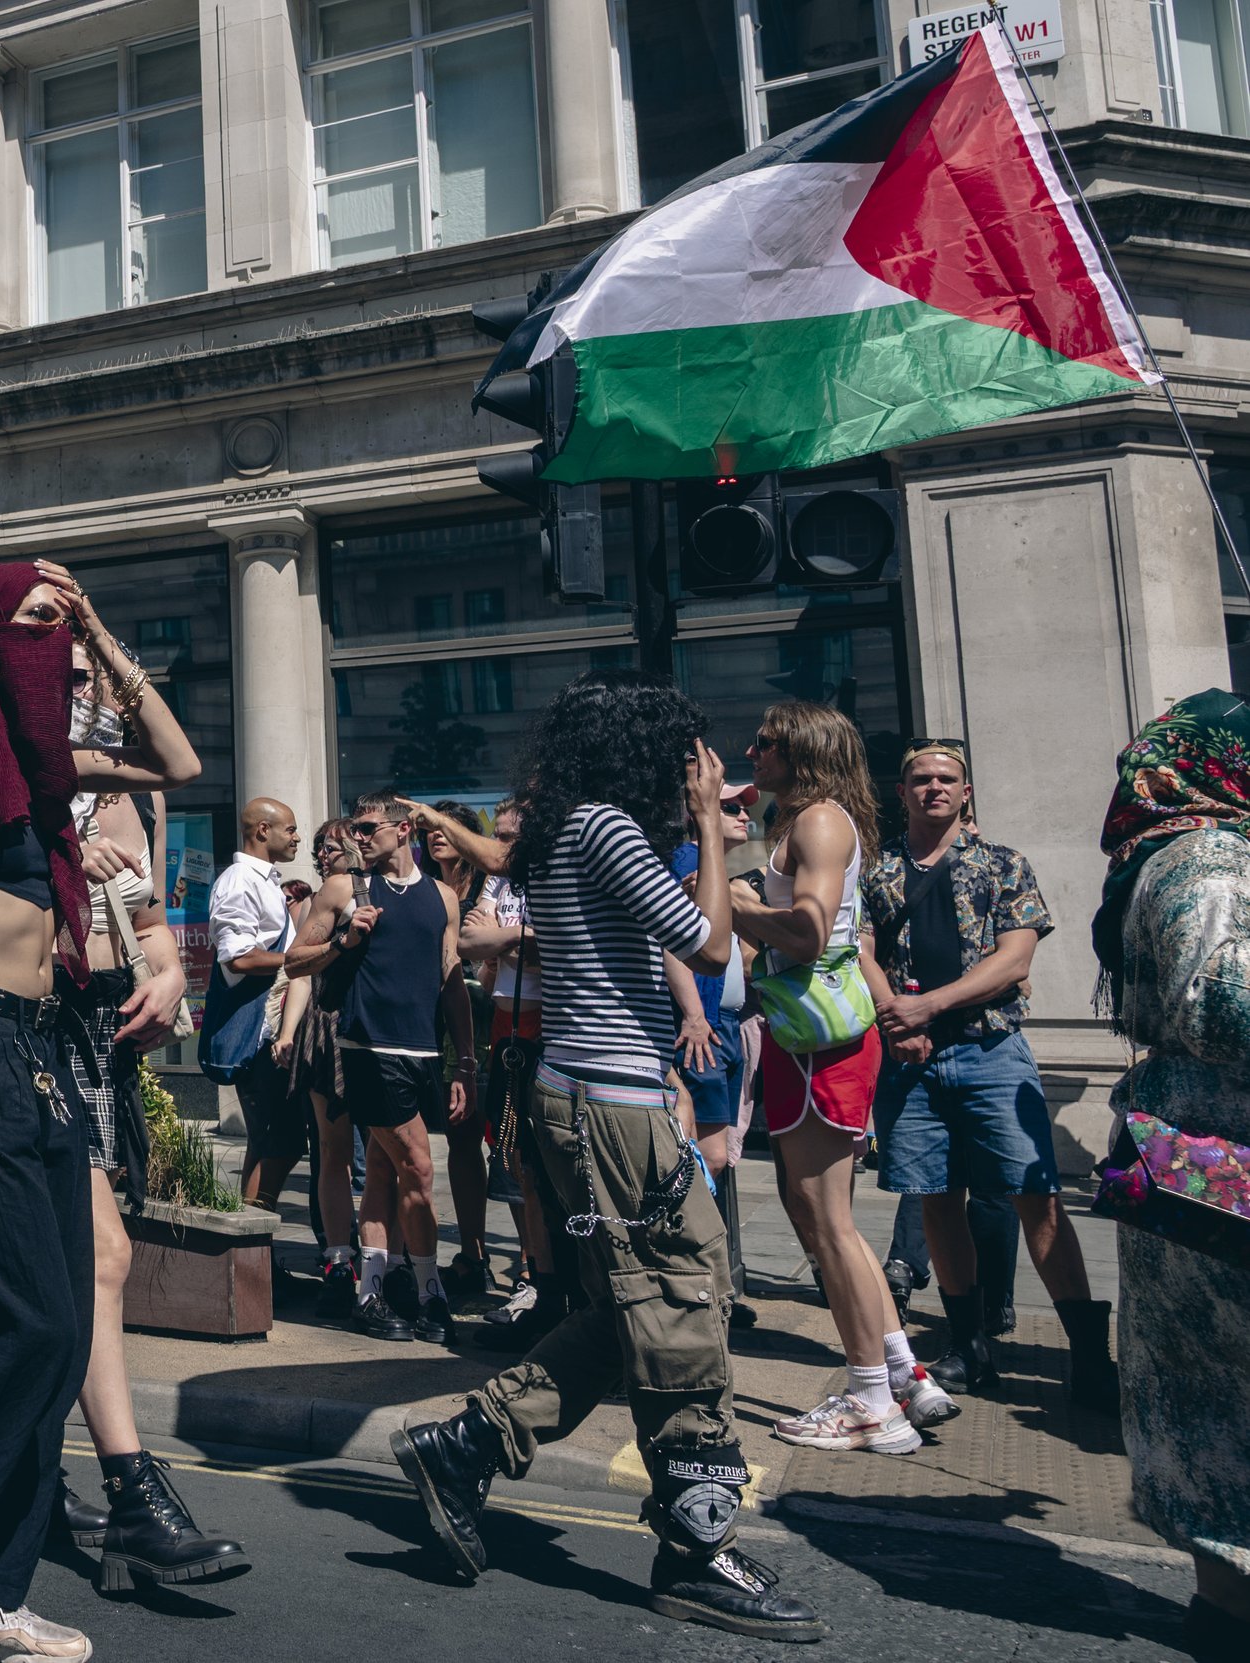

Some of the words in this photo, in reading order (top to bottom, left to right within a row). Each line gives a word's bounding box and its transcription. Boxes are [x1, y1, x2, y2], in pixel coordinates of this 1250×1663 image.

[922, 5, 1008, 40] REGENT
[1014, 20, 1049, 42] W1
[668, 1459, 704, 1474] RENT
[708, 1464, 747, 1478] STRIKE
